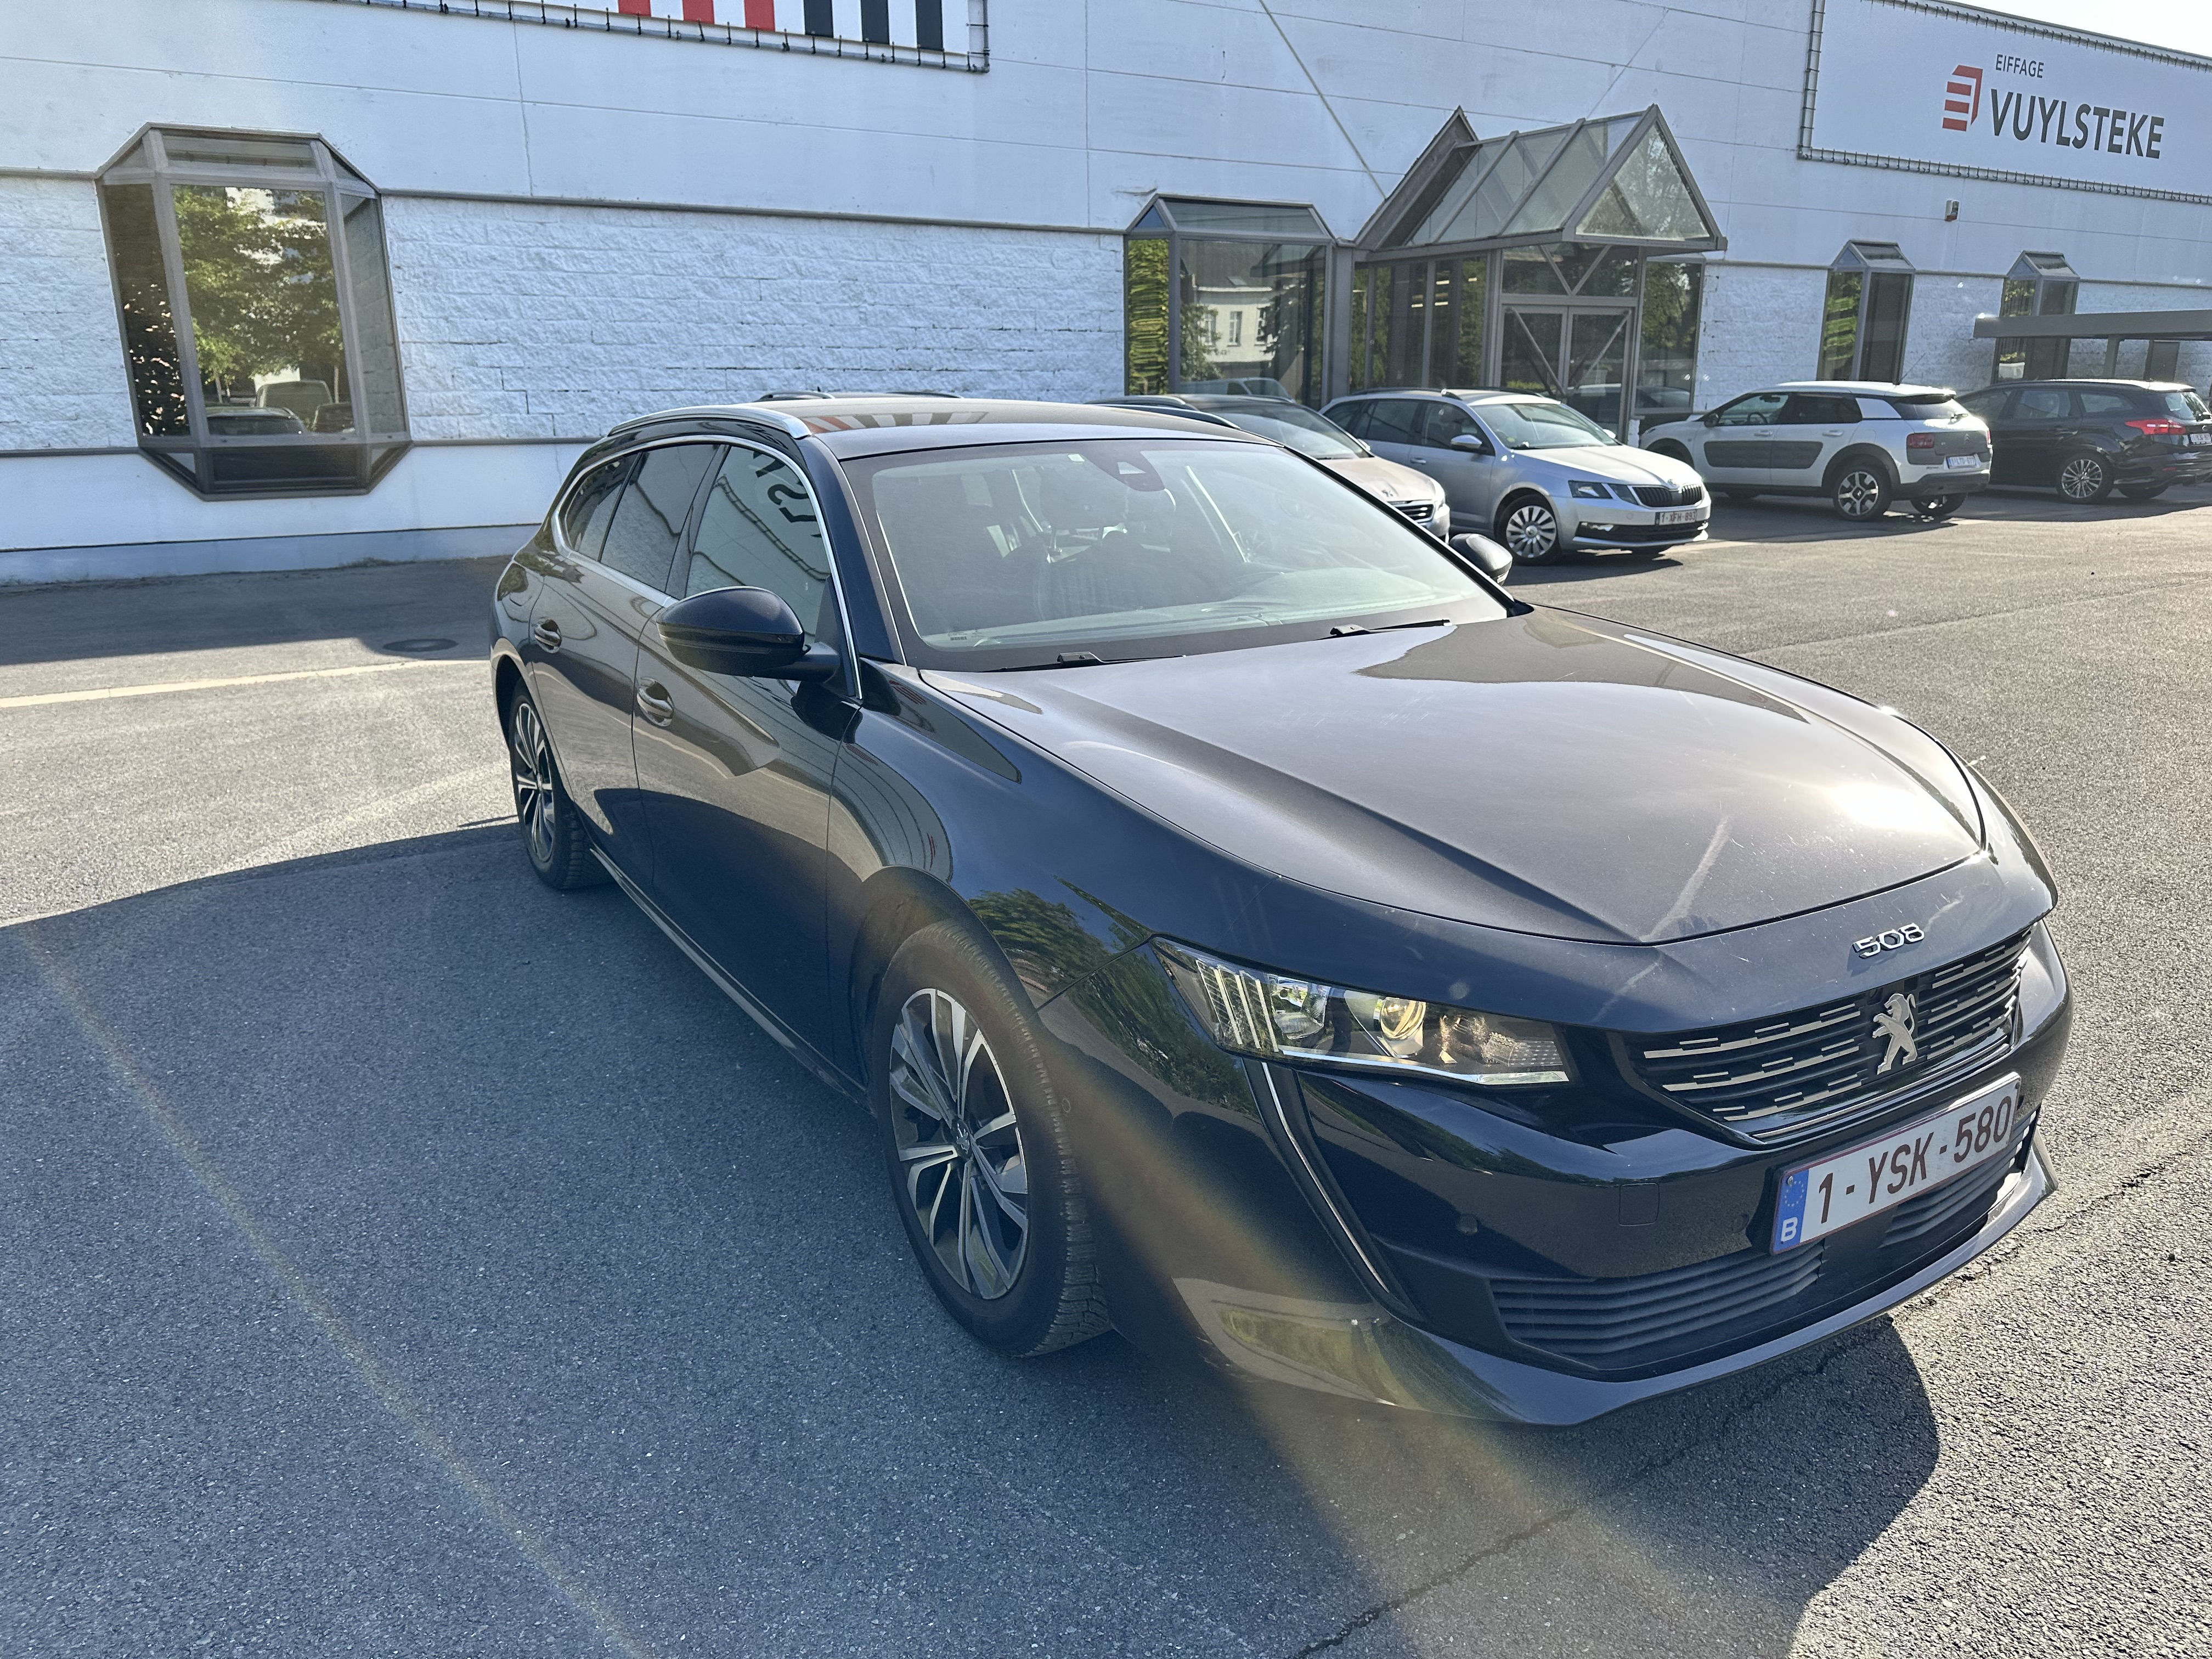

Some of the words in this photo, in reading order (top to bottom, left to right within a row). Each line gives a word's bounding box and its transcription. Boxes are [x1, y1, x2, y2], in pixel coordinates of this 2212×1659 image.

[1995, 54, 2045, 78] EIFFAGE
[1990, 88, 2165, 159] VUYLSTEKE
[1852, 922, 1925, 959] 508
[1780, 1216, 1798, 1243] B
